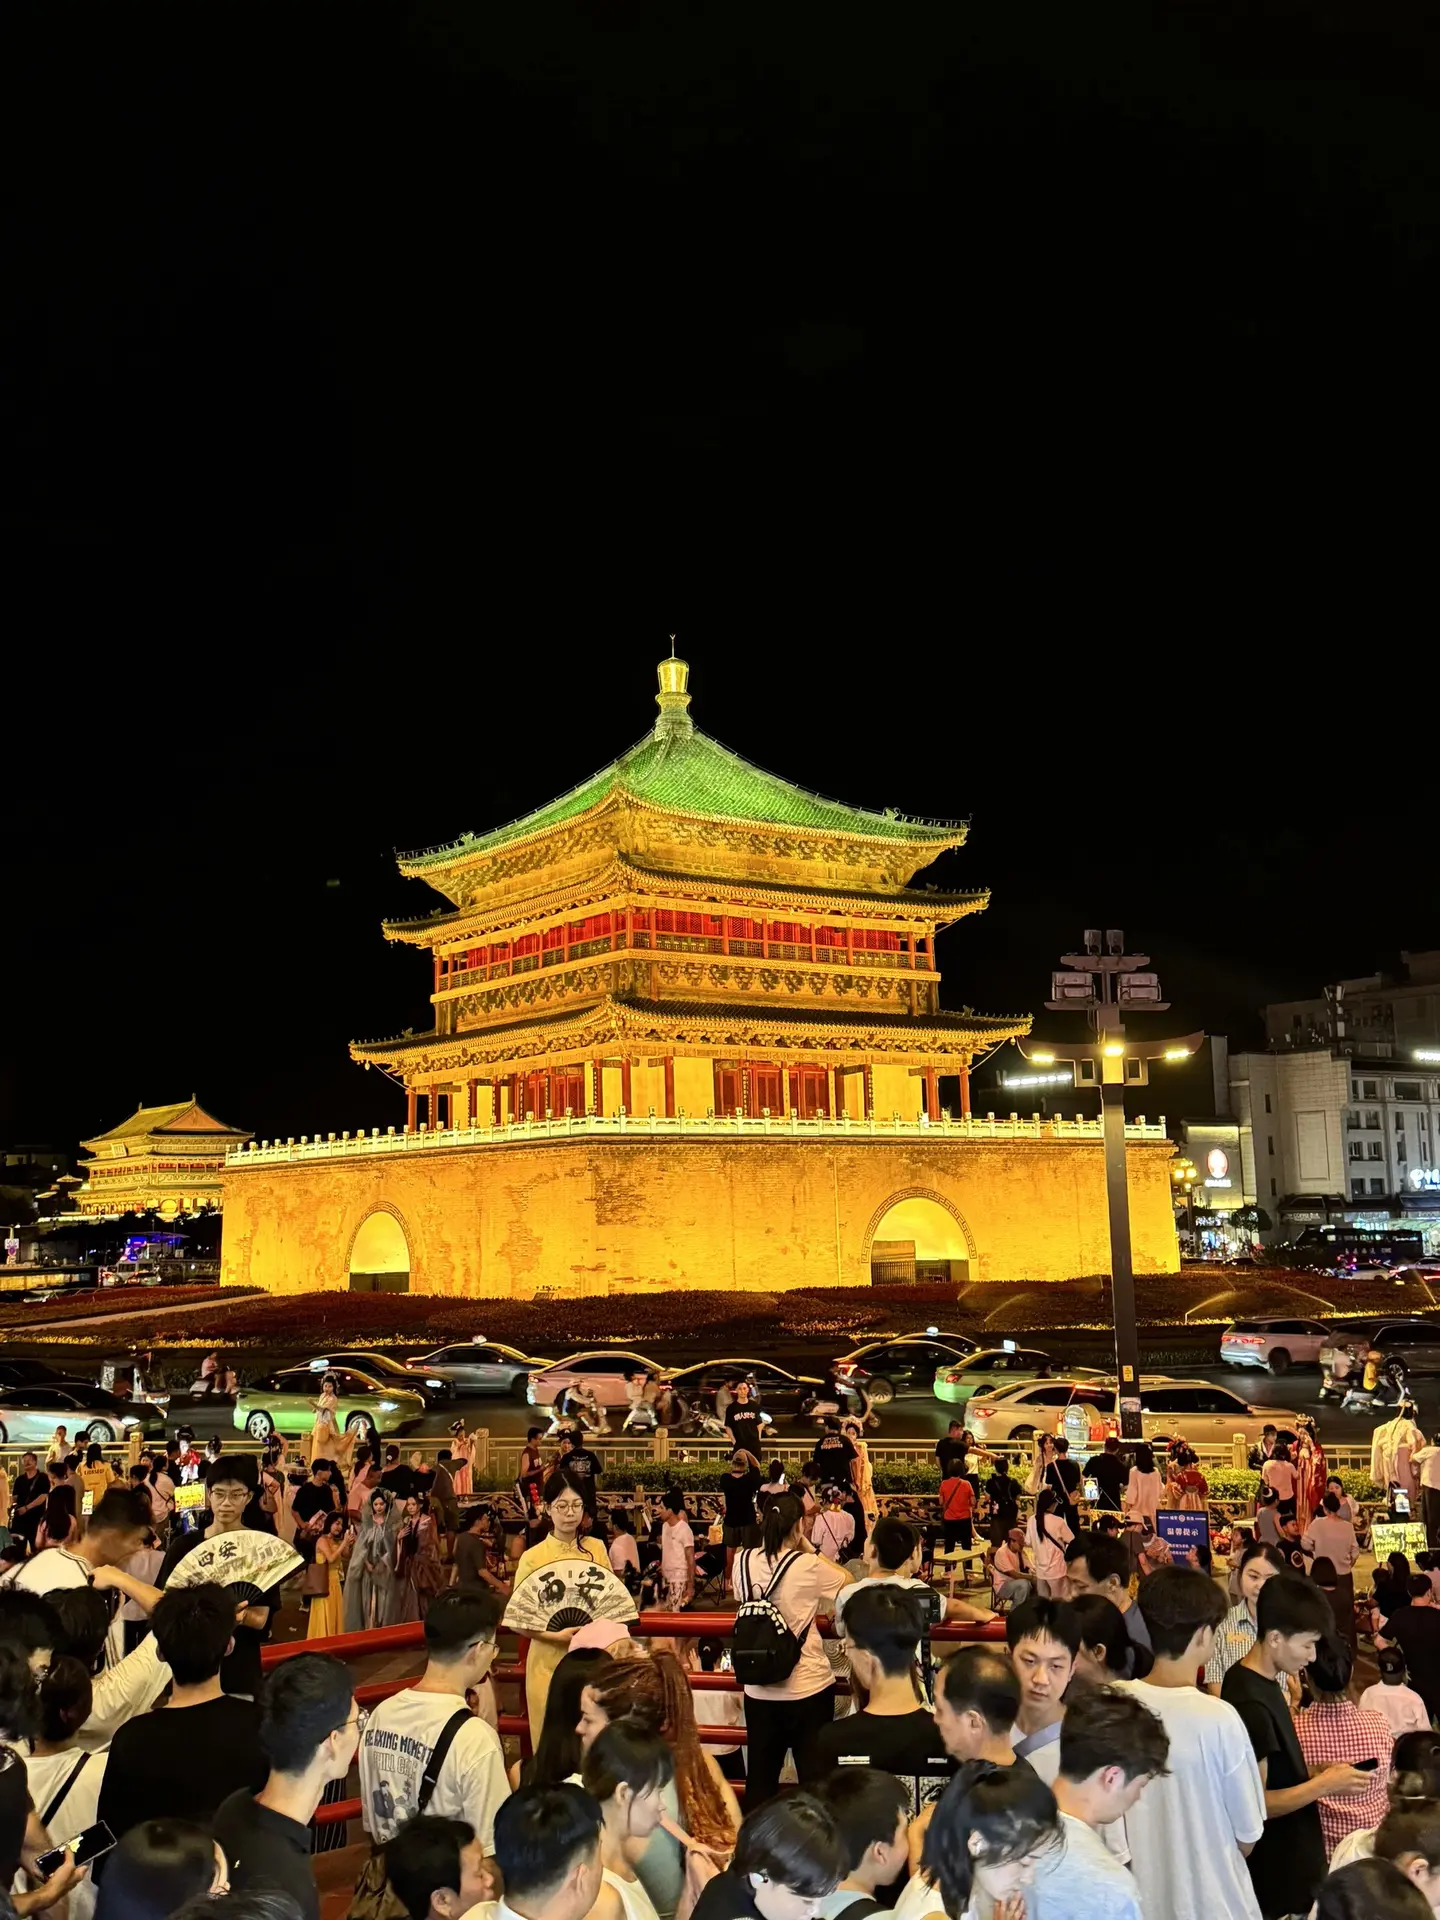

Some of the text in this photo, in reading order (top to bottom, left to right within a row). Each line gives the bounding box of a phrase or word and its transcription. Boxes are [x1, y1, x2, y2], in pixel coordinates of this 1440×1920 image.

[198, 1541, 238, 1567] 西安
[537, 1566, 605, 1611] 西安
[364, 1729, 398, 1751] REAXING
